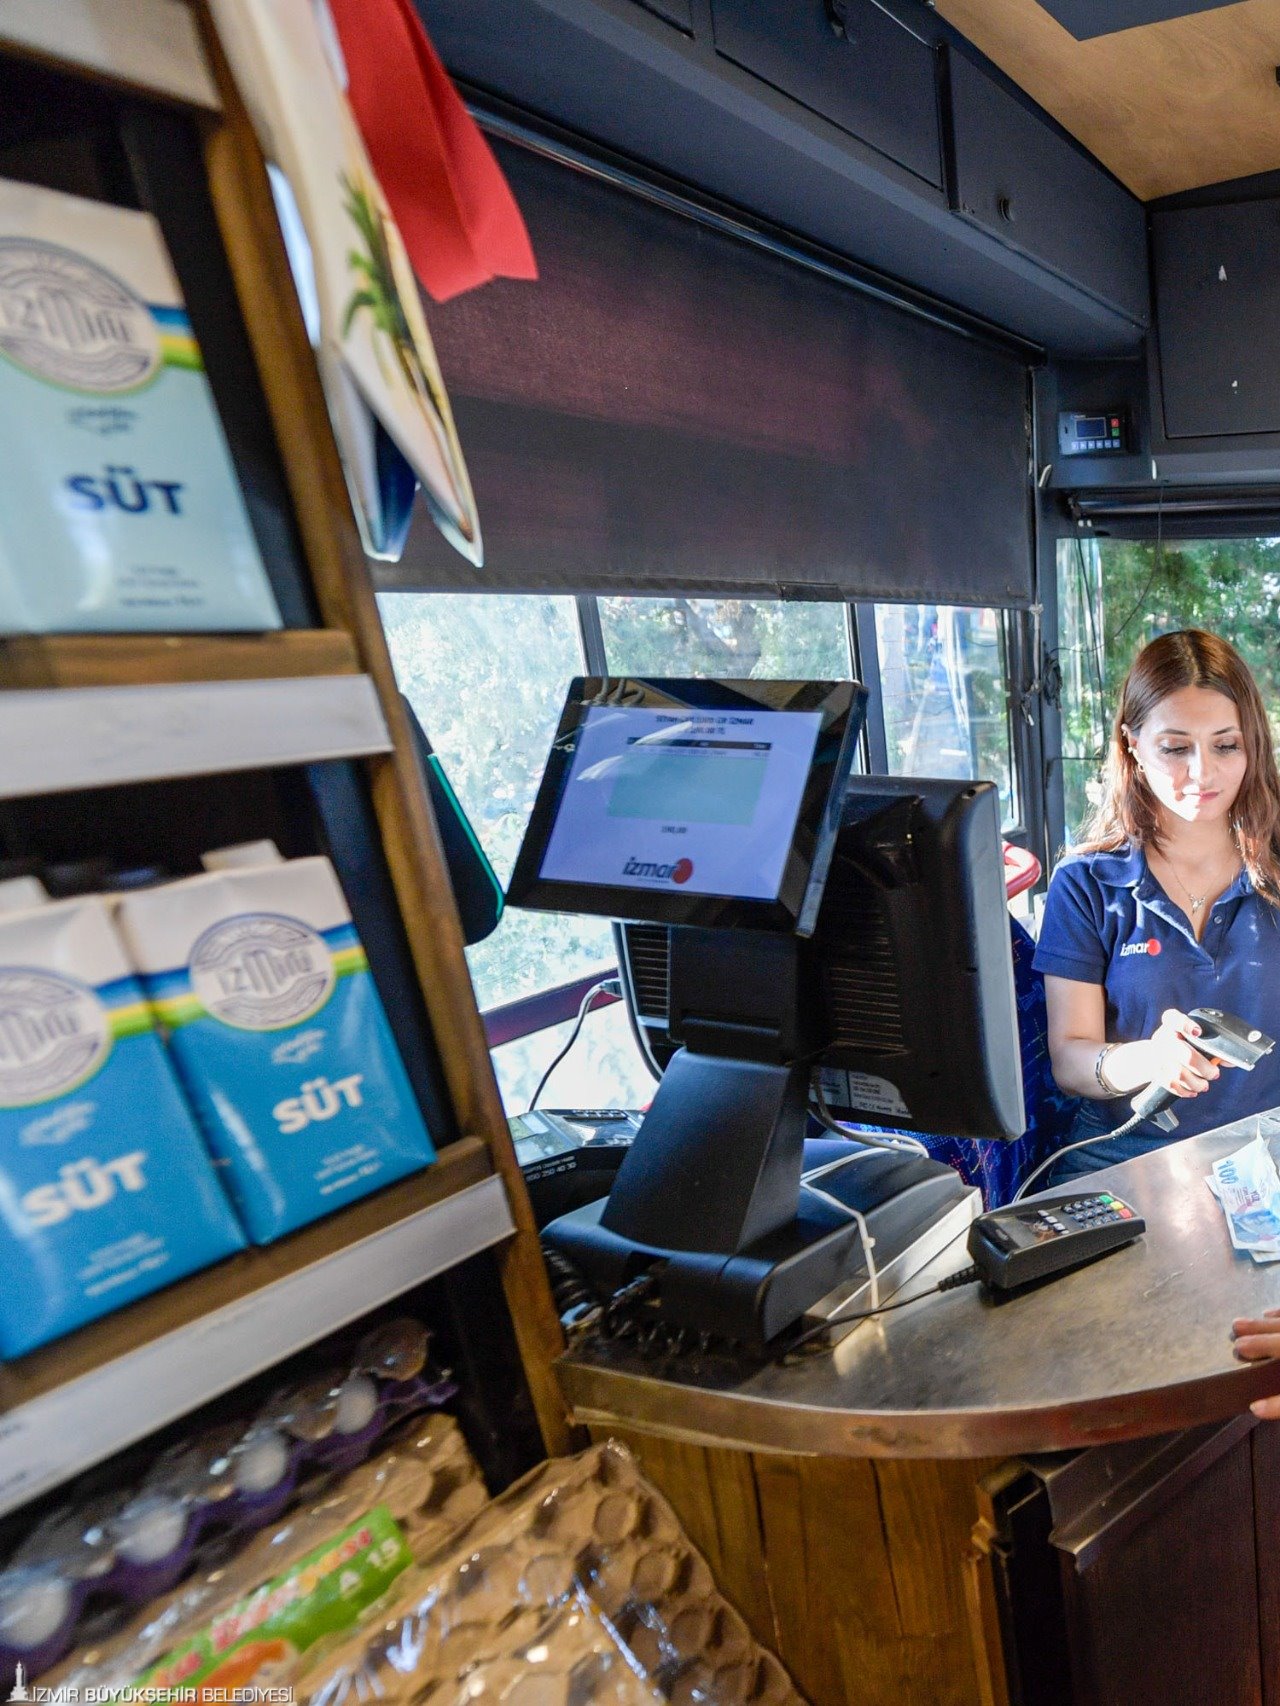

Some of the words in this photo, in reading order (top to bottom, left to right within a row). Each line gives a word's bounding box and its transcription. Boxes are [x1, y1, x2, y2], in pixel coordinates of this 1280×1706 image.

[66, 464, 184, 516] SÜT
[1120, 943, 1150, 957] izmar
[272, 1073, 364, 1134] SÜT
[22, 1150, 147, 1229] SÜT
[1218, 1160, 1239, 1184] 100
